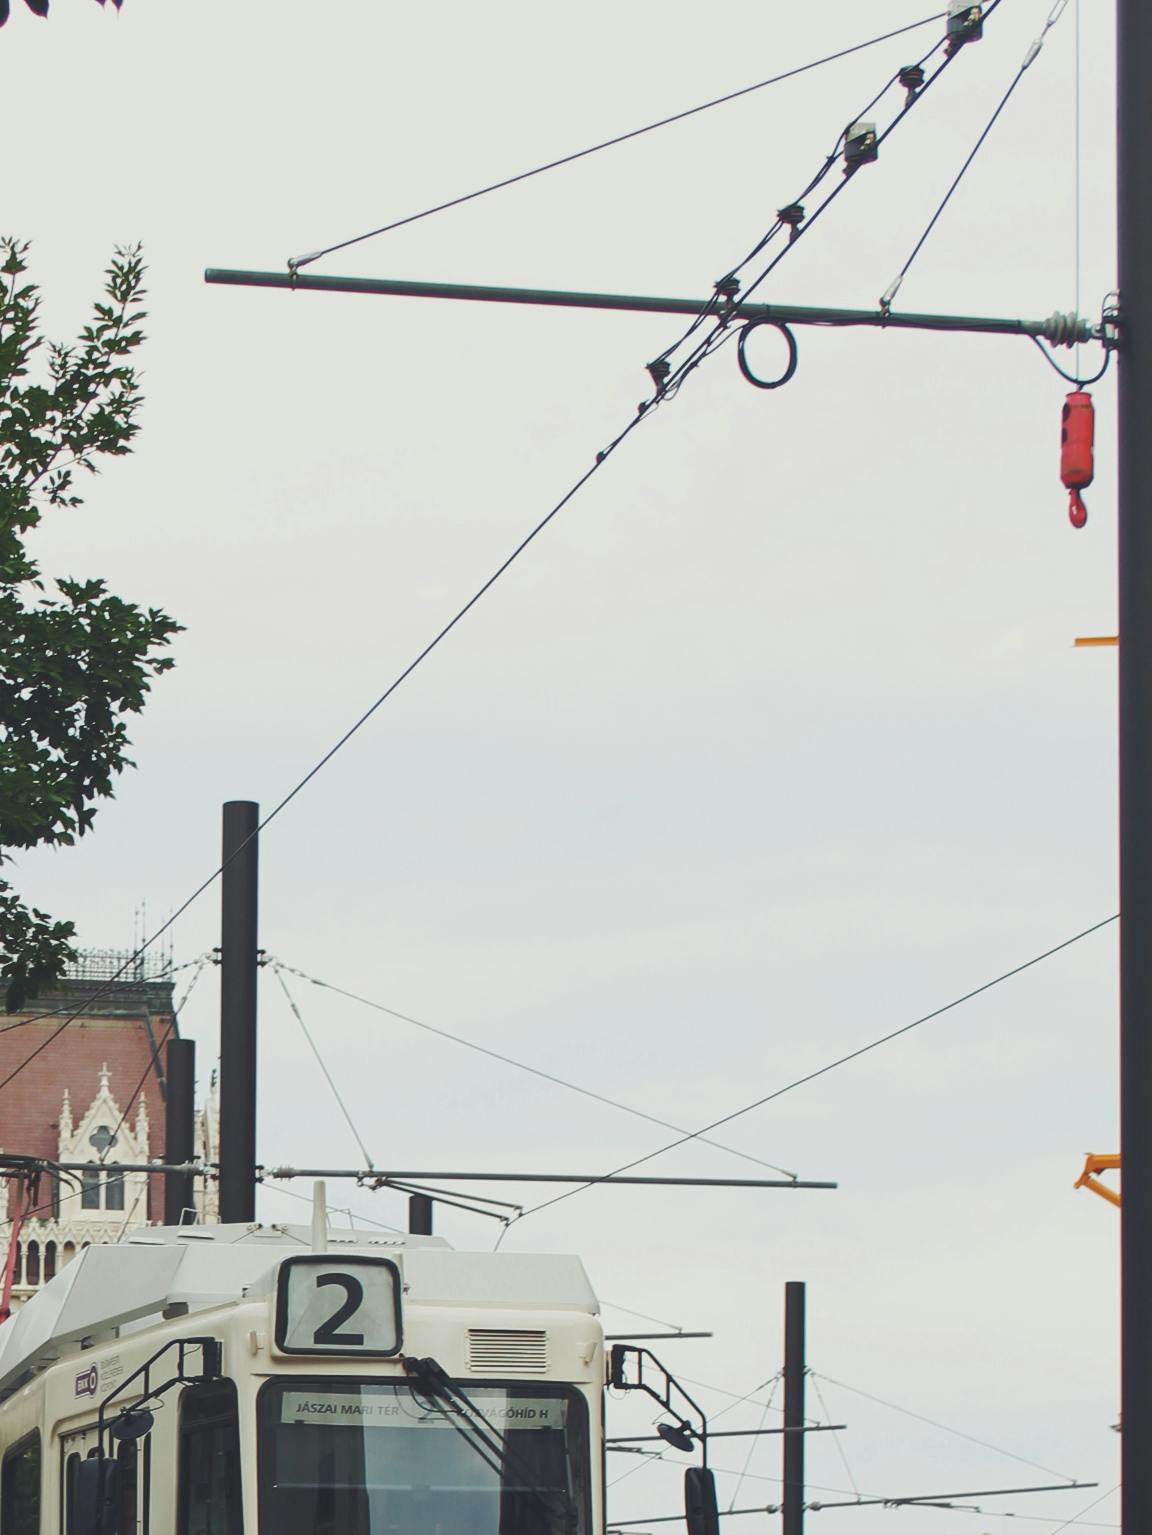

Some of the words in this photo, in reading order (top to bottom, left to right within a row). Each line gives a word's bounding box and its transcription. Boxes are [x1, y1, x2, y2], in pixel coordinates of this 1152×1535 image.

[313, 1272, 364, 1346] 2
[296, 1401, 337, 1414] JÁSZAI
[341, 1405, 373, 1415] MARI
[377, 1404, 399, 1416] TÉR
